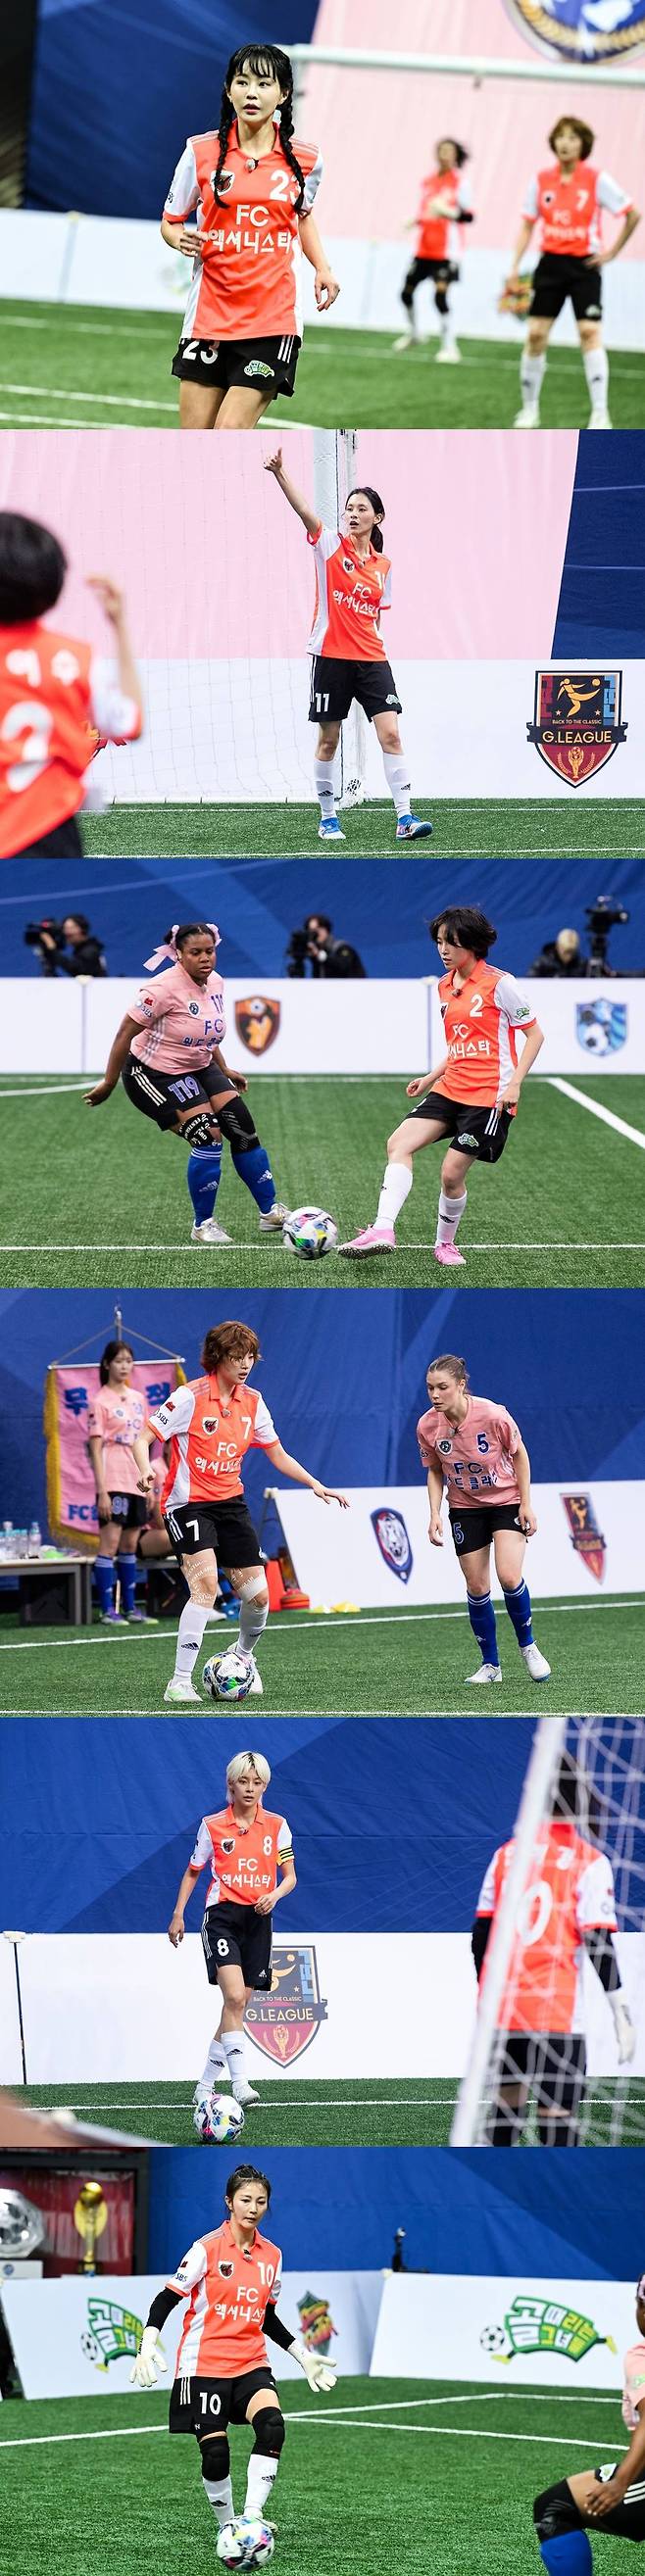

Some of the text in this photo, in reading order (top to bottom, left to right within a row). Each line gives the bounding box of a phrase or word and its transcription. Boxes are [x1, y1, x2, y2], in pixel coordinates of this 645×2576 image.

[236, 205, 269, 227] FC
[208, 228, 291, 254] 액셔니스타
[352, 582, 372, 600] FC
[315, 692, 330, 713] 11
[542, 730, 613, 744] G.LEAGUE
[470, 994, 483, 1018] 2
[204, 1018, 223, 1036] FC
[453, 1024, 470, 1039] FC
[168, 1076, 200, 1103] 119
[156, 1412, 169, 1425] SBS
[241, 1416, 252, 1439] 7
[217, 1441, 237, 1457] FC
[476, 1432, 490, 1454] 5
[453, 1462, 483, 1474] FC
[185, 1519, 200, 1541] 7
[452, 1522, 465, 1544] 5
[263, 1835, 273, 1856] 8
[238, 1858, 259, 1871] FC
[222, 1873, 272, 1889] 액셔니스타
[217, 1938, 229, 1956] 8
[245, 2008, 314, 2021] G.LEAGUE
[175, 2272, 187, 2282] SBS
[257, 2261, 274, 2288] 10
[236, 2287, 259, 2303] FC
[199, 2392, 223, 2415] 10
